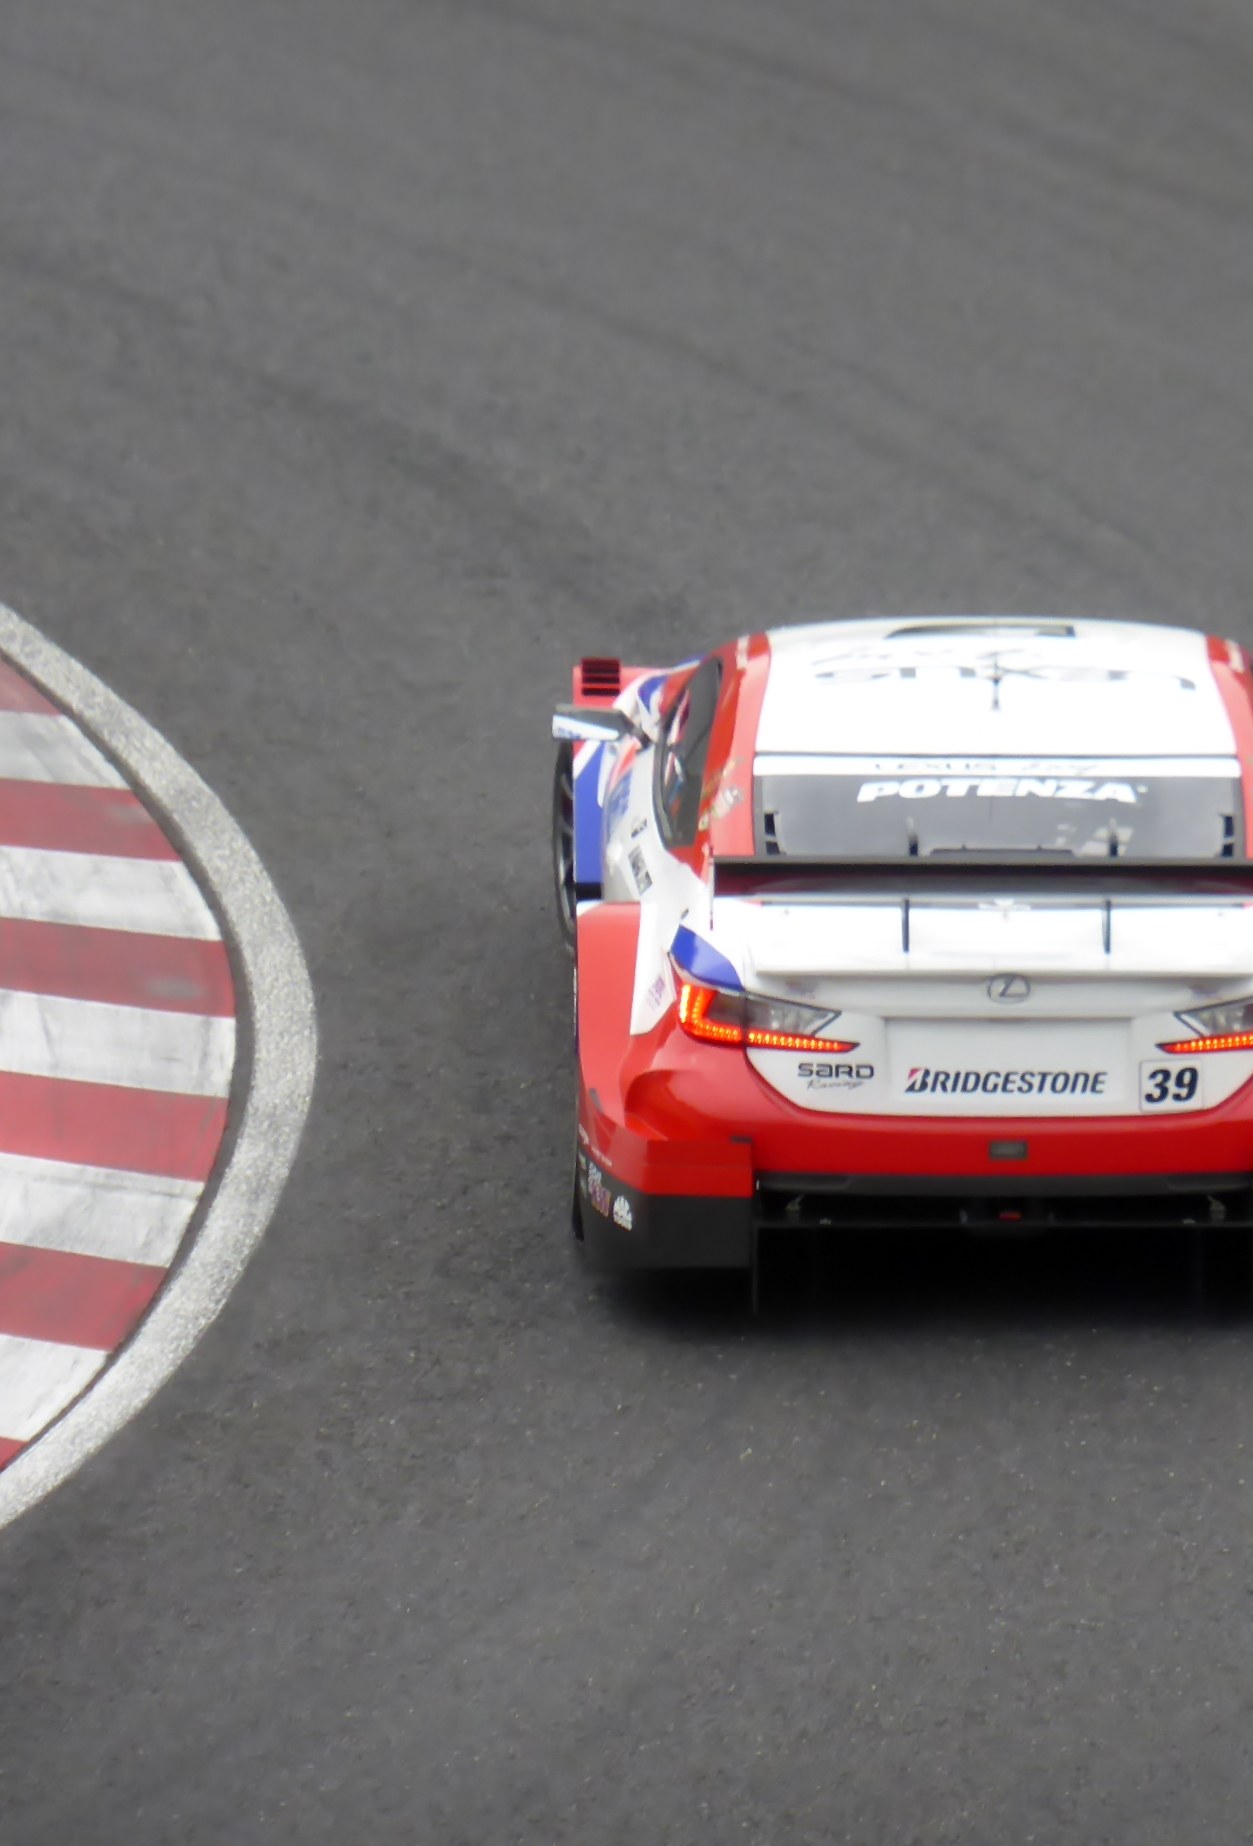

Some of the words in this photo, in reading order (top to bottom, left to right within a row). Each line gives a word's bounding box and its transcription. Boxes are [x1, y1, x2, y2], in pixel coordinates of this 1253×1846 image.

[857, 777, 1137, 803] POTENZA
[905, 1067, 1107, 1095] BRIDGESTONE
[1144, 1067, 1198, 1103] 39
